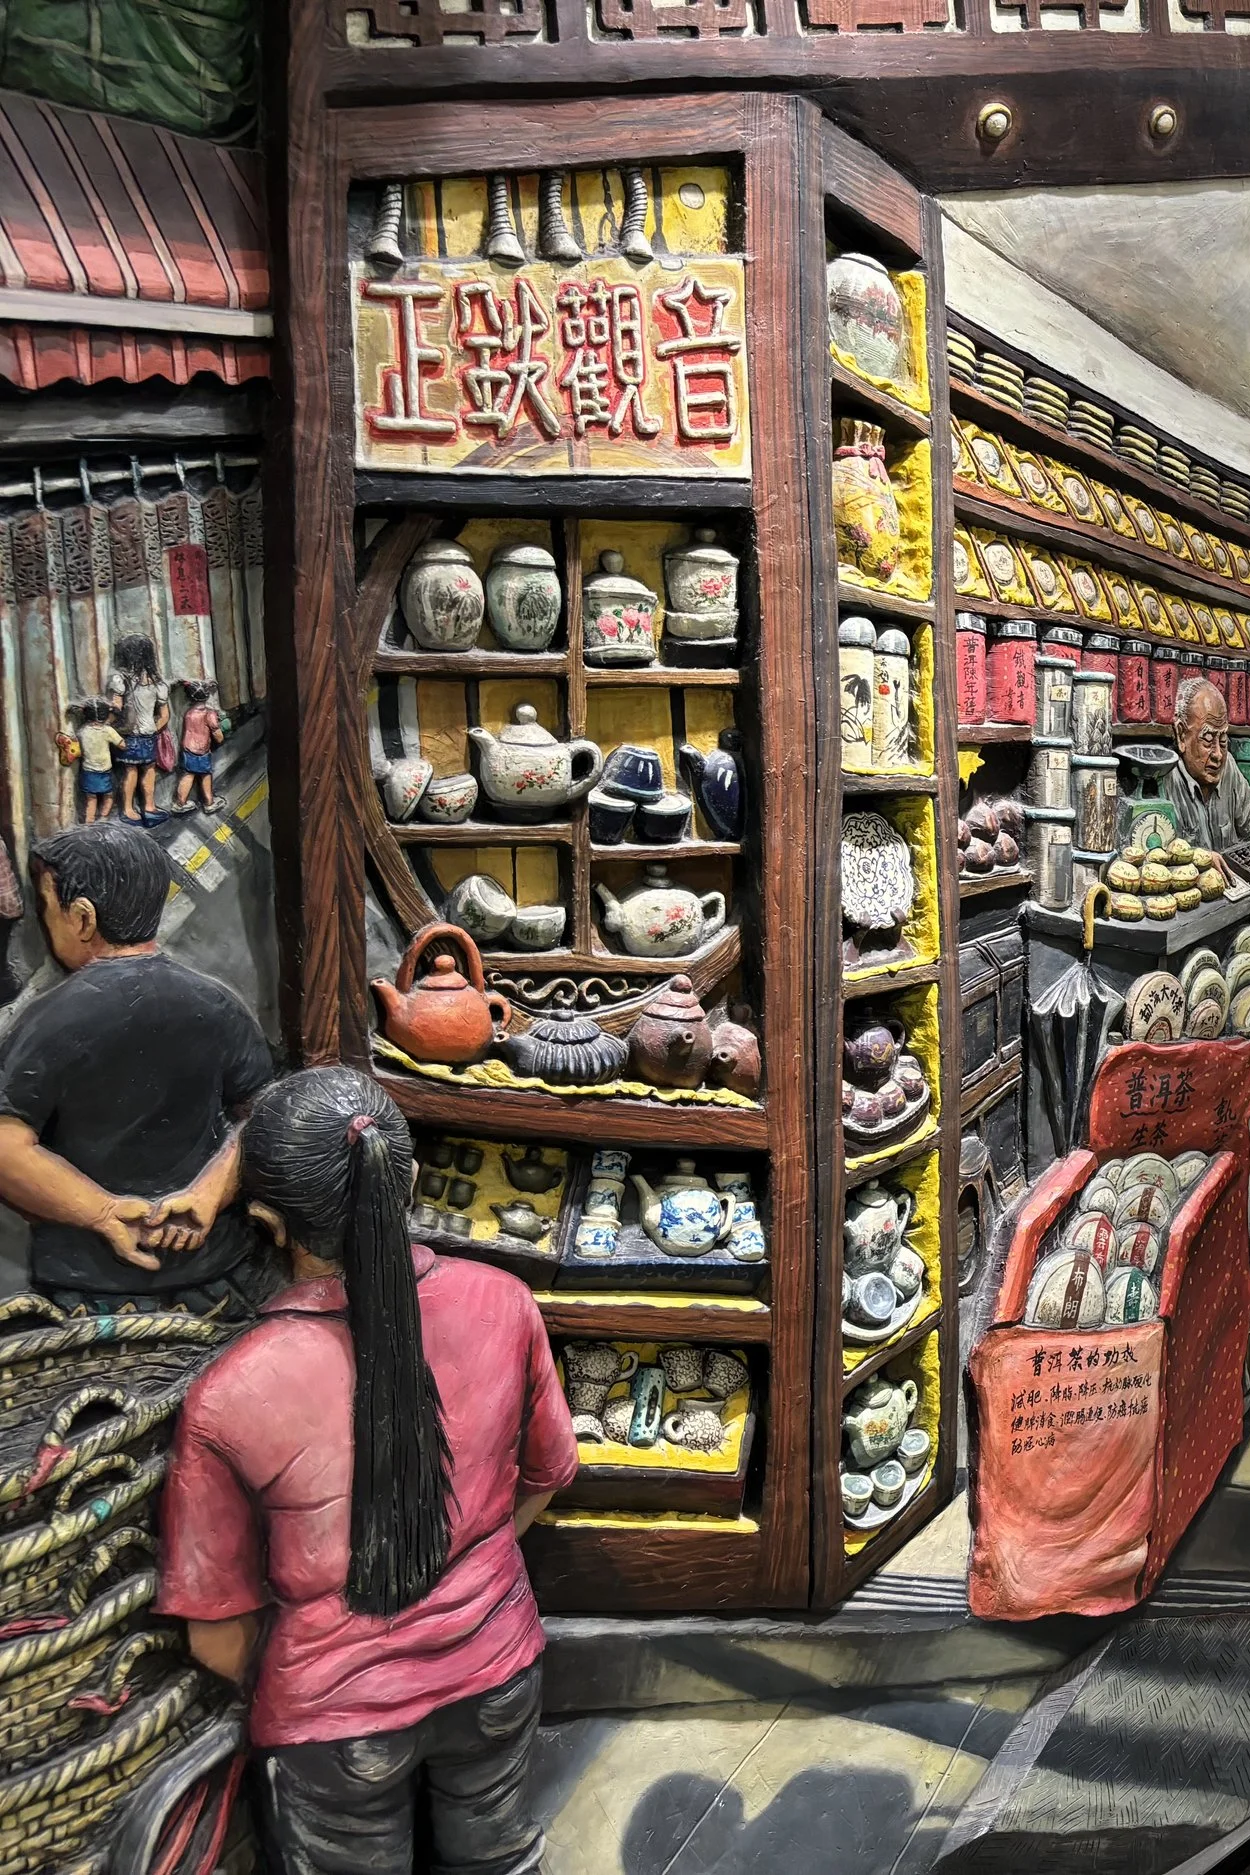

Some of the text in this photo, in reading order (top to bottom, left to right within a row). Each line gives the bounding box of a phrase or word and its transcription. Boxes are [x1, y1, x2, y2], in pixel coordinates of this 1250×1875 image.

[1125, 1066, 1196, 1109] 普洱茶
[1063, 1268, 1085, 1319] 布朗
